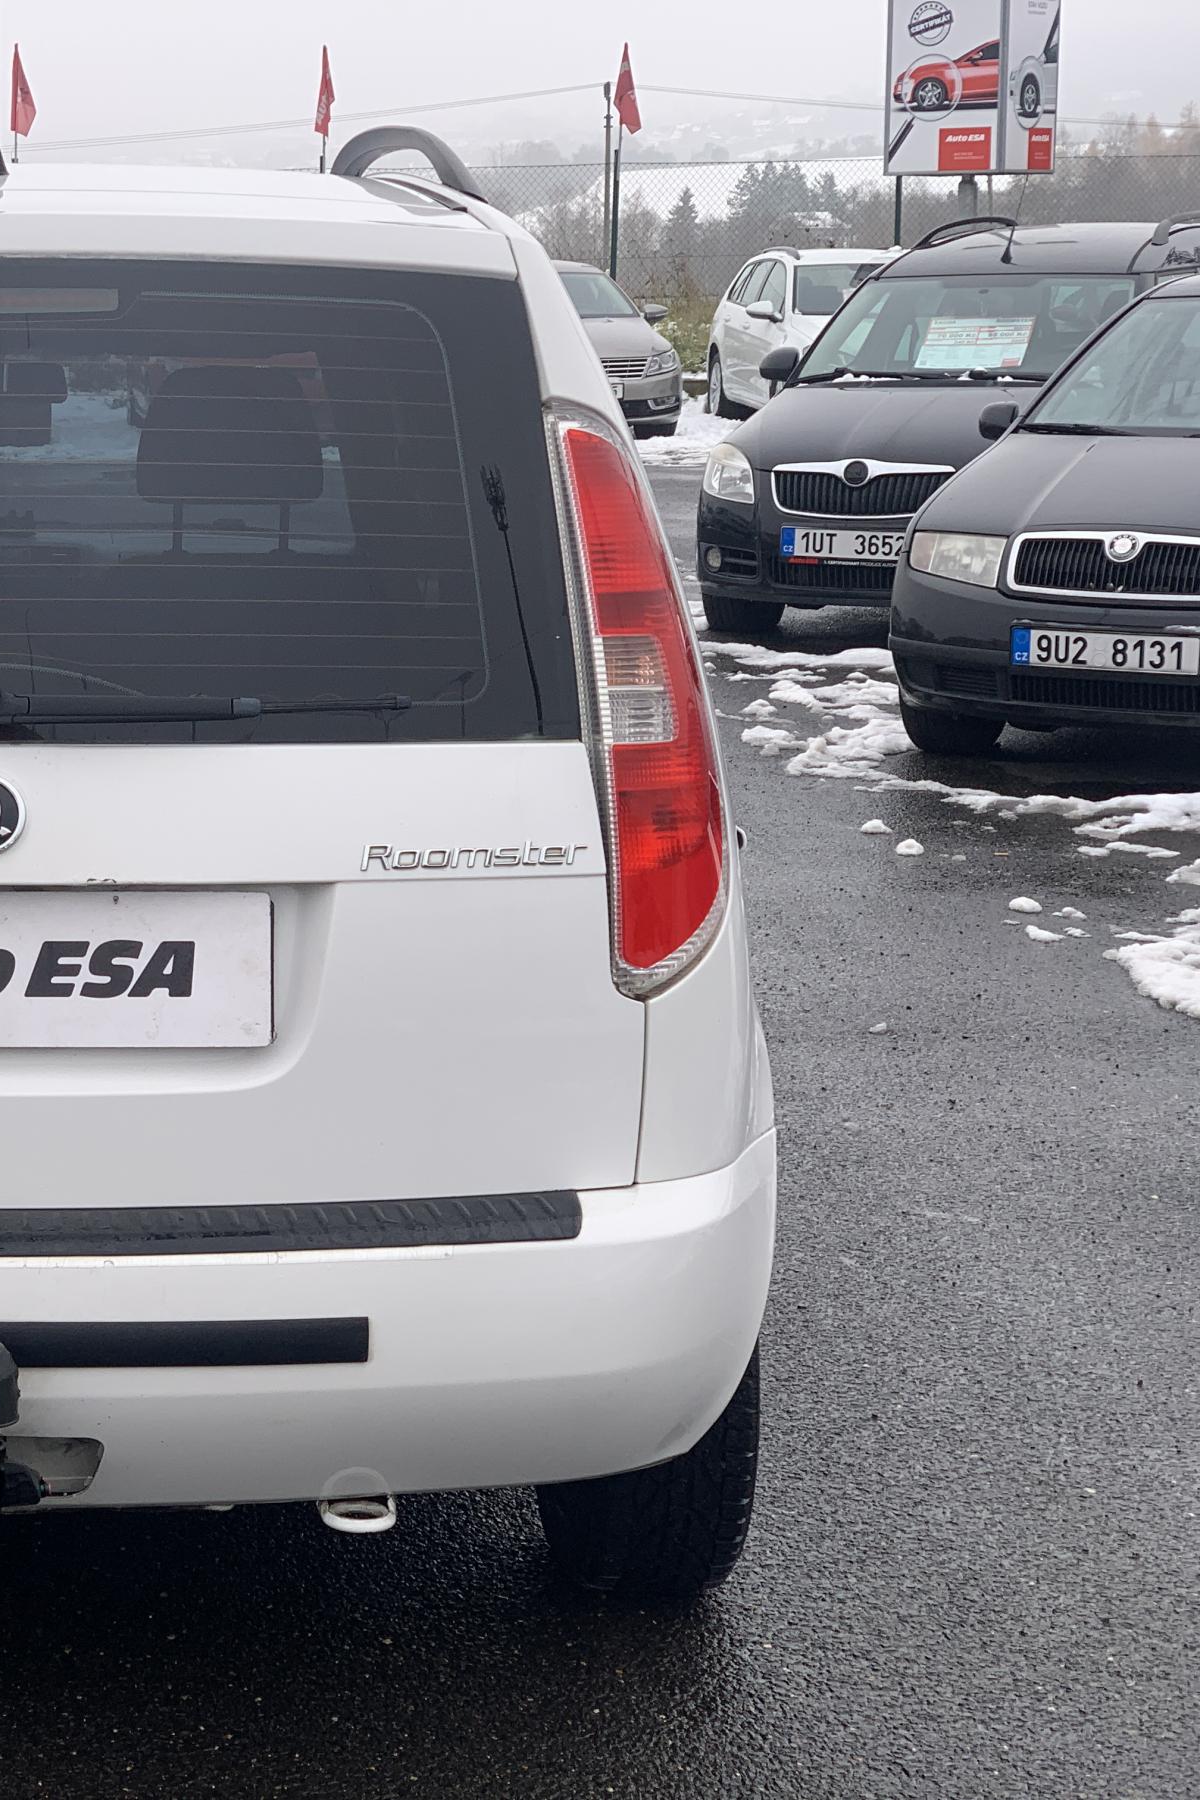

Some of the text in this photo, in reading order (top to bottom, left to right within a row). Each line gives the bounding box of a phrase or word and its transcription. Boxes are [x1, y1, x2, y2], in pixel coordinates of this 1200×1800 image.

[783, 544, 794, 553] CZ
[801, 532, 837, 554] 1UT
[1015, 652, 1029, 661] CZ
[1036, 634, 1183, 670] 9U2 8131
[360, 840, 588, 871] Roomster
[24, 940, 196, 999] ESA
